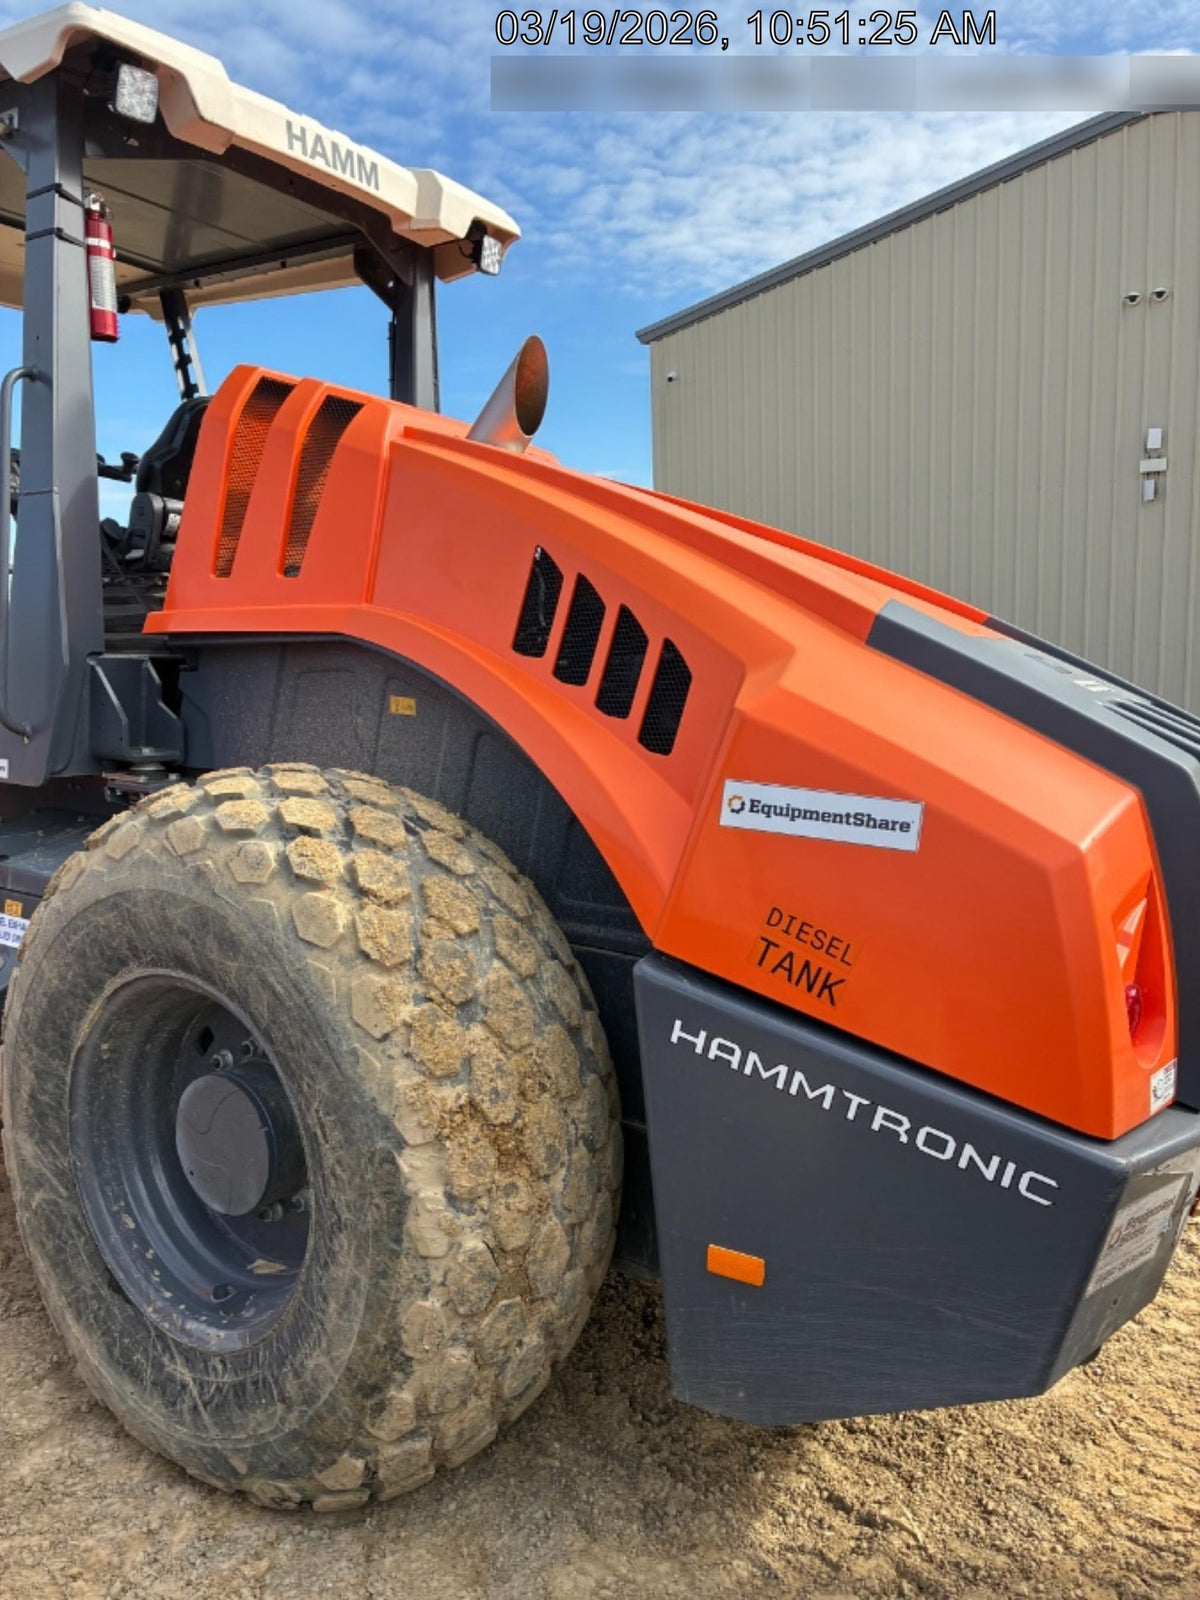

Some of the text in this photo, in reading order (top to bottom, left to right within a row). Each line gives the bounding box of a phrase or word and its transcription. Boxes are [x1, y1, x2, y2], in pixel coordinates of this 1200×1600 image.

[285, 119, 380, 191] HAMM
[748, 798, 912, 833] EquipmentShare
[757, 936, 847, 1007] TANK
[765, 906, 853, 967] DIESEL
[670, 1019, 1060, 1207] HAMMTRONIC
